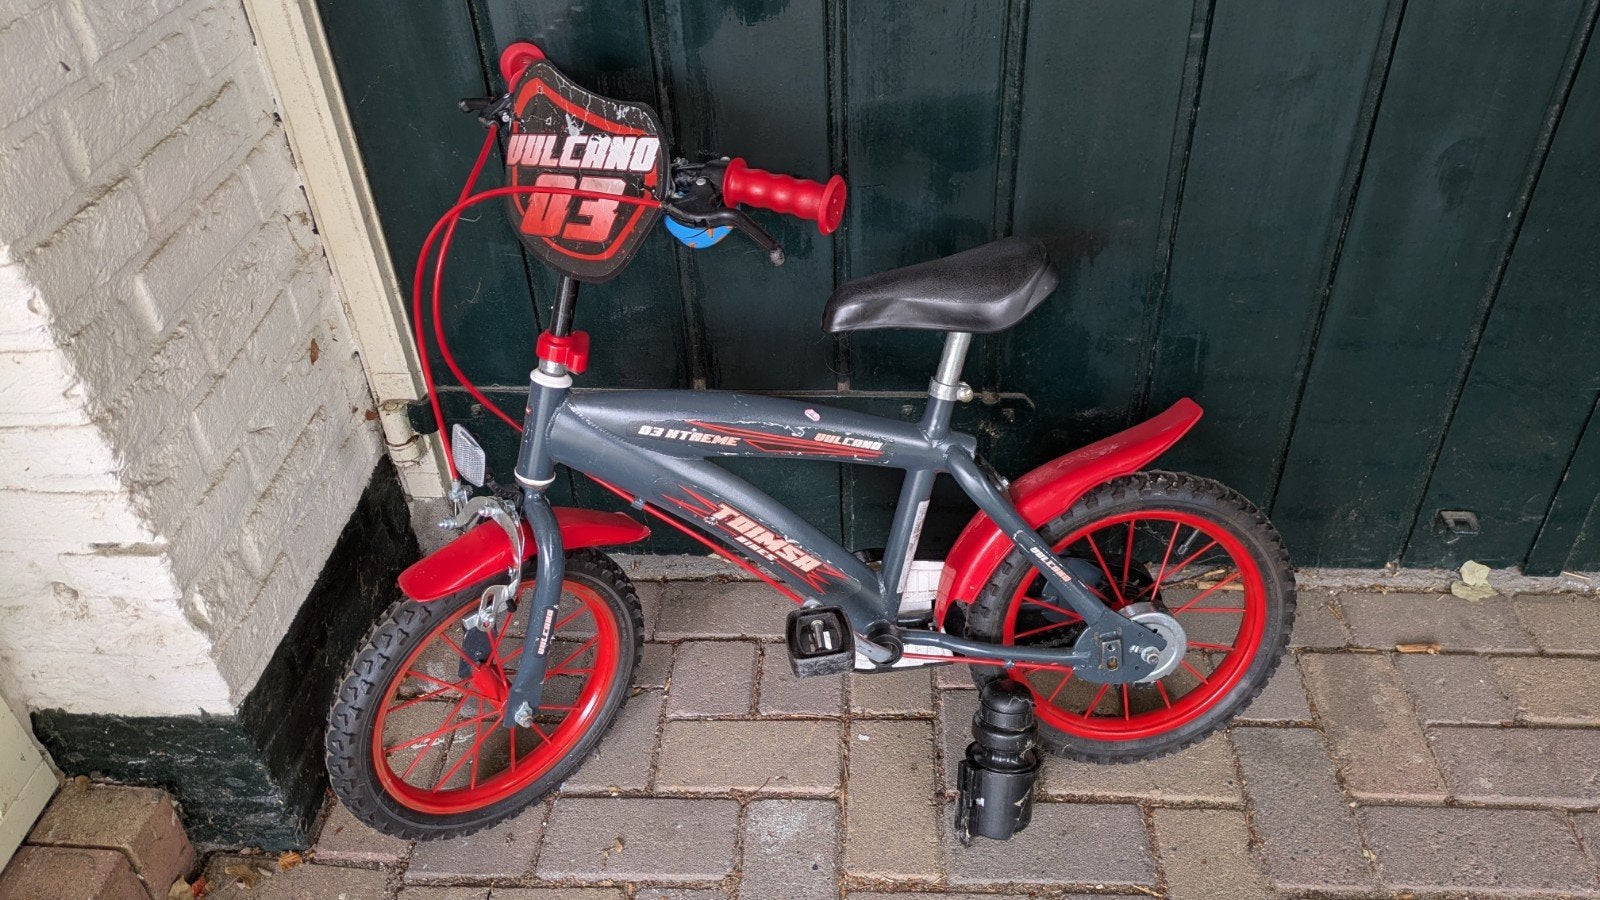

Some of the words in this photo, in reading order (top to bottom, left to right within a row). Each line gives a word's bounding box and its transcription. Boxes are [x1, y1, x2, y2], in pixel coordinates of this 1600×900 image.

[507, 134, 660, 172] VULCANO
[520, 174, 626, 243] 03
[638, 425, 664, 437] 03
[665, 428, 741, 446] XTREME
[814, 432, 883, 450] VULCANO
[710, 502, 823, 573] TOIMSA
[1030, 546, 1072, 582] VULCANO
[537, 609, 554, 655] VULCANO
